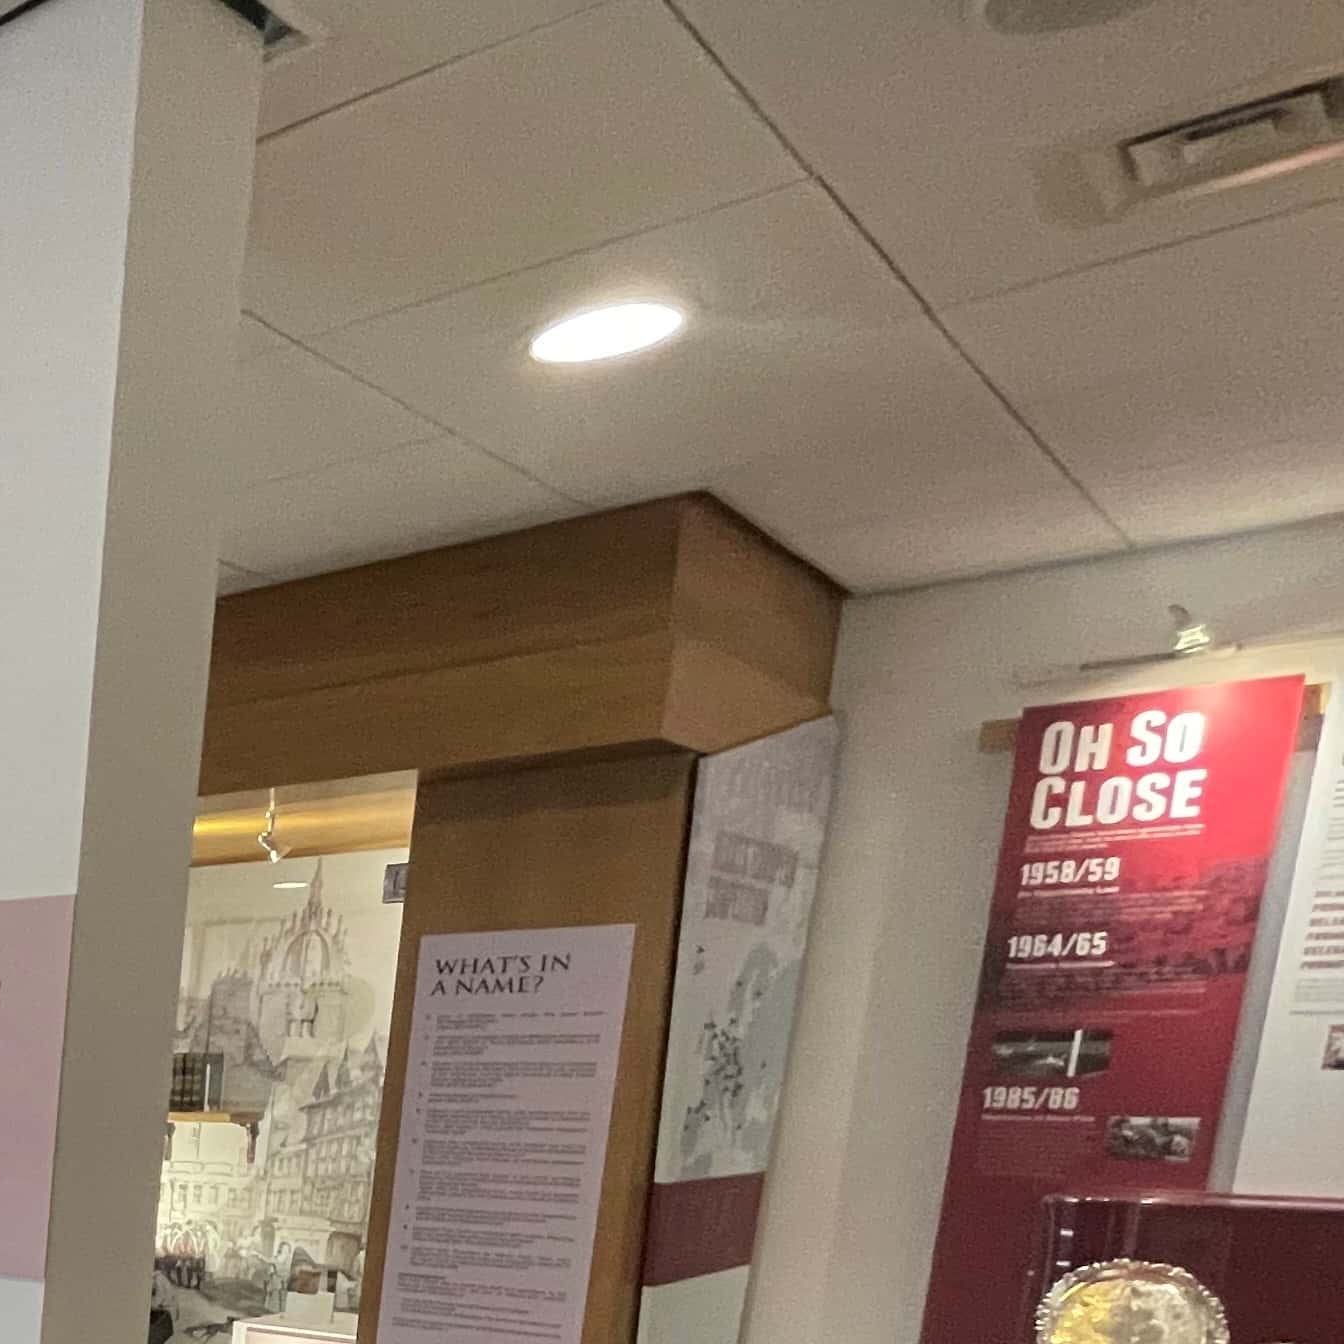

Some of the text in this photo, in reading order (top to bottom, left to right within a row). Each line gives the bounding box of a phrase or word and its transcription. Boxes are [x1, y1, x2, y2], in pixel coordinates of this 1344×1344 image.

[1039, 709, 1207, 775] OH SO
[1029, 768, 1208, 830] CLOSE
[1019, 856, 1121, 886] 1958/59
[1007, 931, 1108, 959] 1964/65
[435, 952, 571, 975] WHAT'S IN
[430, 976, 544, 996] A NAME?
